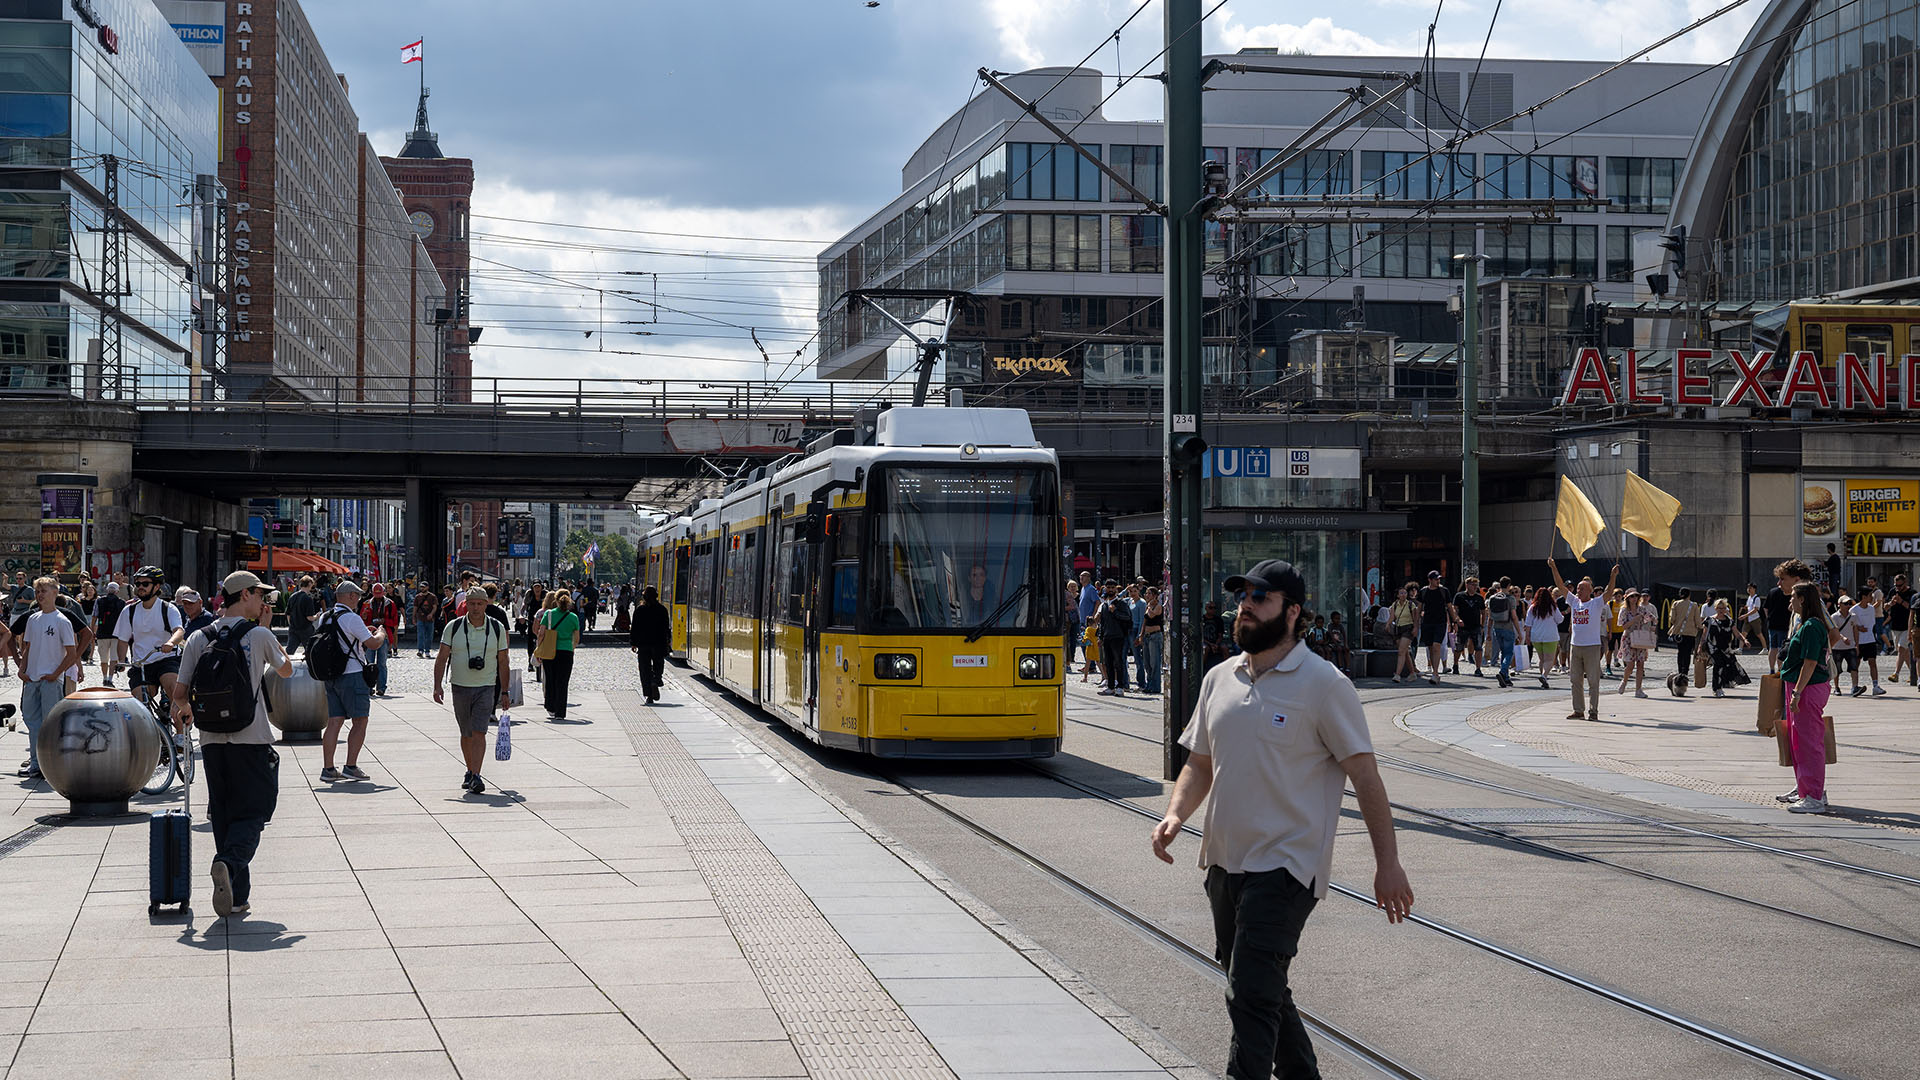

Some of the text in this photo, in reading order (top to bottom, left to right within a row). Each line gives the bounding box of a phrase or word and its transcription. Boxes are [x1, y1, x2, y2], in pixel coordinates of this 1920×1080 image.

[173, 27, 220, 40] ATHLON
[234, 3, 253, 341] RATHAUS PASSAGEN
[1175, 415, 1193, 424] 234
[1217, 449, 1238, 476] U
[1293, 452, 1308, 461] U8
[1293, 465, 1308, 475] U5
[1850, 488, 1900, 501] BURGER
[1874, 500, 1916, 512] MITTE?
[1254, 514, 1339, 527] U Alexanderplatz
[1851, 512, 1888, 524] BITTE!
[53, 532, 78, 542] DYLAN
